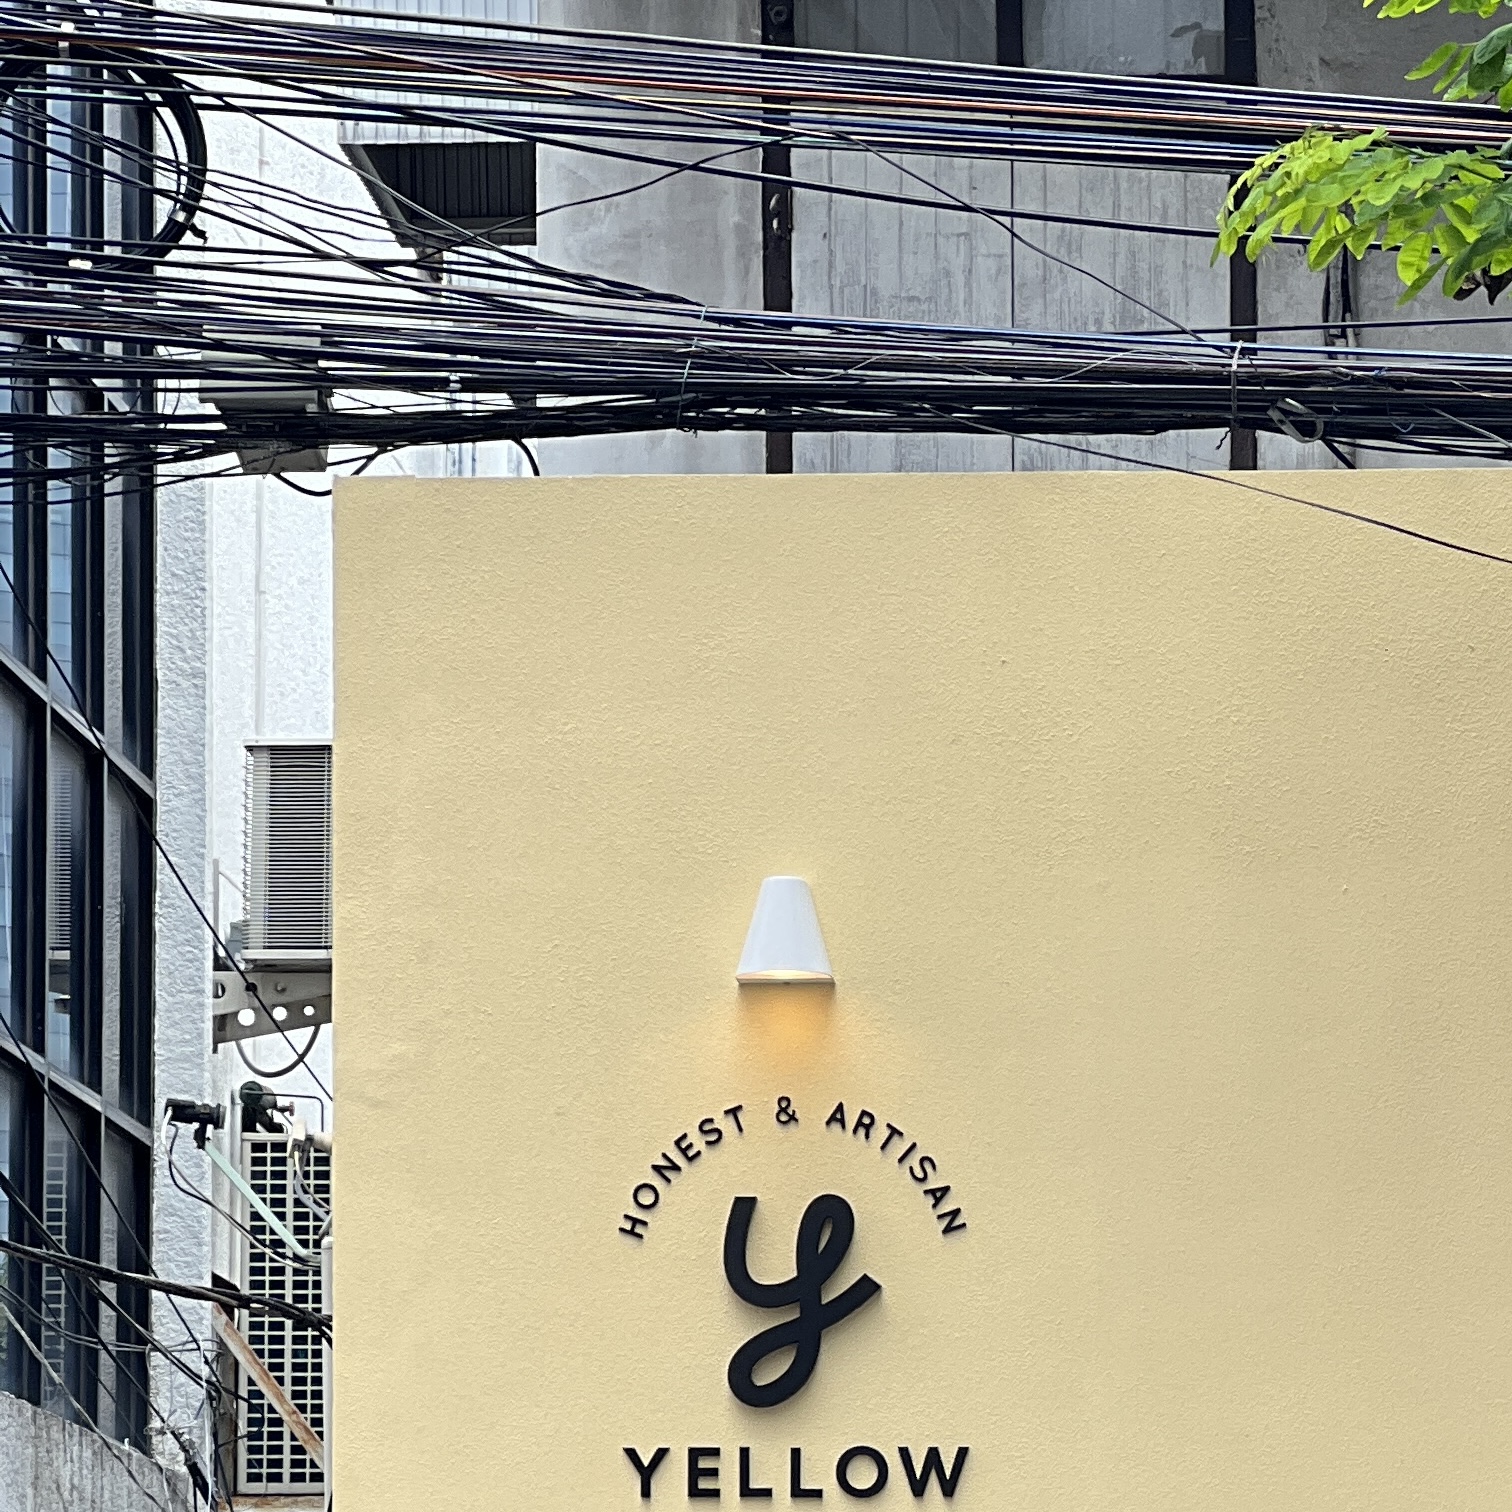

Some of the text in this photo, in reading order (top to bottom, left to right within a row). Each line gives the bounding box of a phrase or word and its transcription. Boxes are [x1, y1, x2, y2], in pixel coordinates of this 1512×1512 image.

[618, 1096, 967, 1240] HONEST & ARTISAN
[622, 1445, 970, 1499] YELLOW
